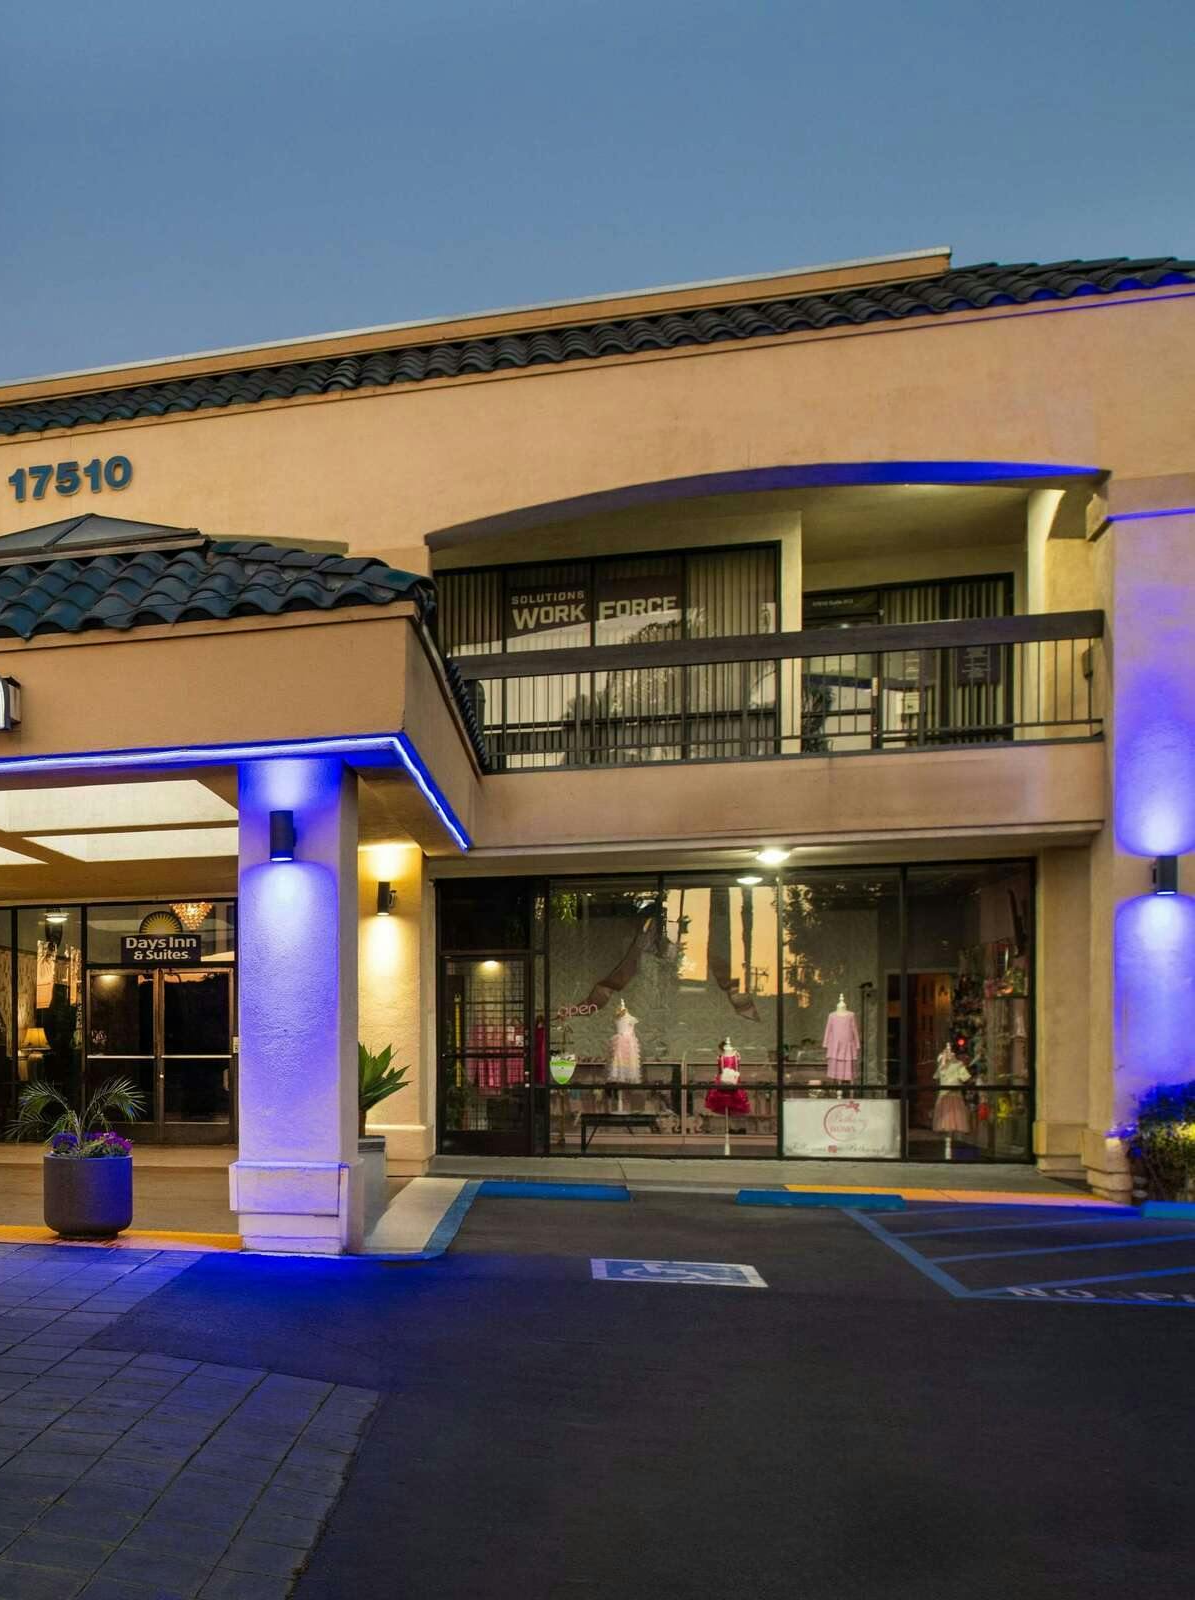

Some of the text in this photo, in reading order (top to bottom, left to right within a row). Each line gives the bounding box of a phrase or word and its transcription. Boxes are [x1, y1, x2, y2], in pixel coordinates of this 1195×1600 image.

[8, 456, 133, 502] 17510
[511, 590, 585, 605] SOLUTIONS
[512, 596, 677, 630] WORK FORCE
[125, 936, 197, 950] Days Inn
[133, 949, 189, 960] & Suites
[557, 1003, 598, 1018] open
[1006, 1286, 1096, 1298] NO
